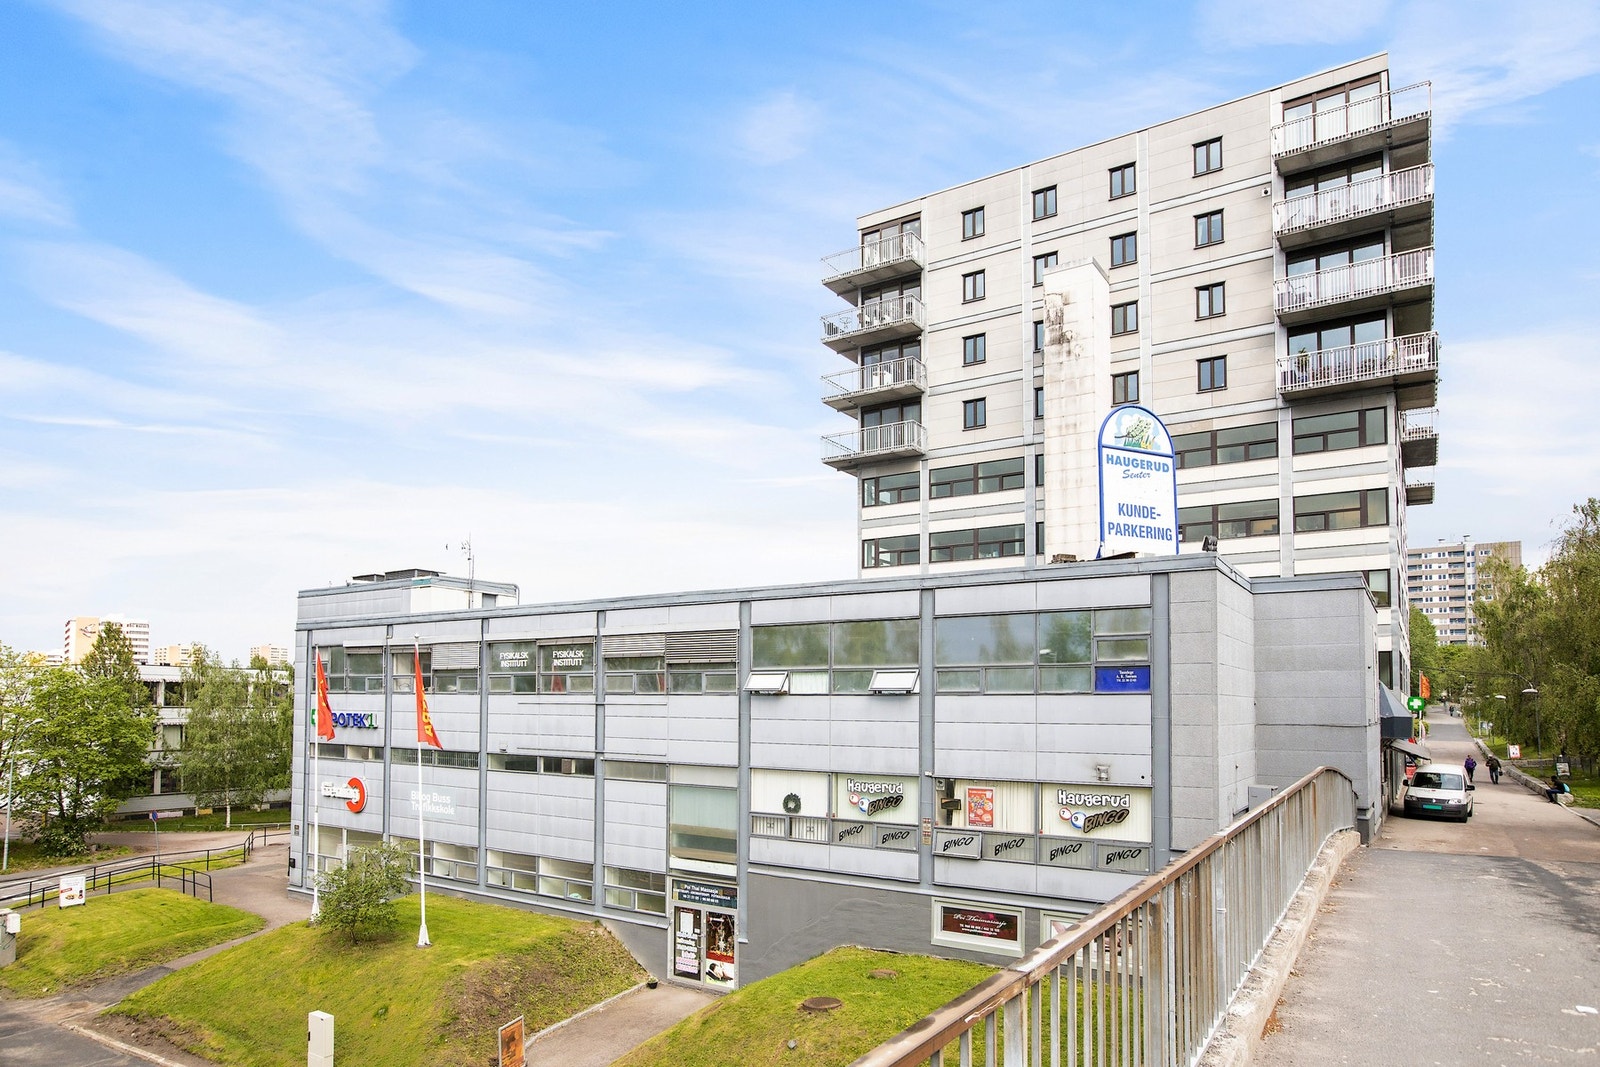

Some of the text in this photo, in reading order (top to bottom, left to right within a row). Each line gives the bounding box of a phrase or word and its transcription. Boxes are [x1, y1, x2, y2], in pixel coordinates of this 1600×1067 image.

[1106, 453, 1169, 473] HAUGERUD
[1122, 469, 1151, 479] Senter
[1118, 502, 1161, 520] KUNDE-
[1107, 521, 1172, 541] PARKERING
[500, 651, 529, 660] FYSIKALSK
[552, 650, 585, 659] FYSIKALSK
[553, 658, 584, 667] INSTITUTT
[500, 659, 528, 668] INSTITUTT
[331, 711, 366, 727] POTEK
[847, 778, 904, 794] Haugerud
[432, 792, 451, 804] Buss
[867, 795, 904, 816] BINGO
[1057, 789, 1131, 808] Haugerud
[411, 800, 455, 815] Trfikkskole
[1083, 809, 1130, 833] BINGO
[838, 825, 864, 841] BINGO
[882, 831, 910, 844] BINGO
[943, 837, 974, 852] BINGO
[994, 838, 1026, 856] BINGO
[1050, 843, 1083, 861] BINGO
[1106, 848, 1142, 865] BINGO
